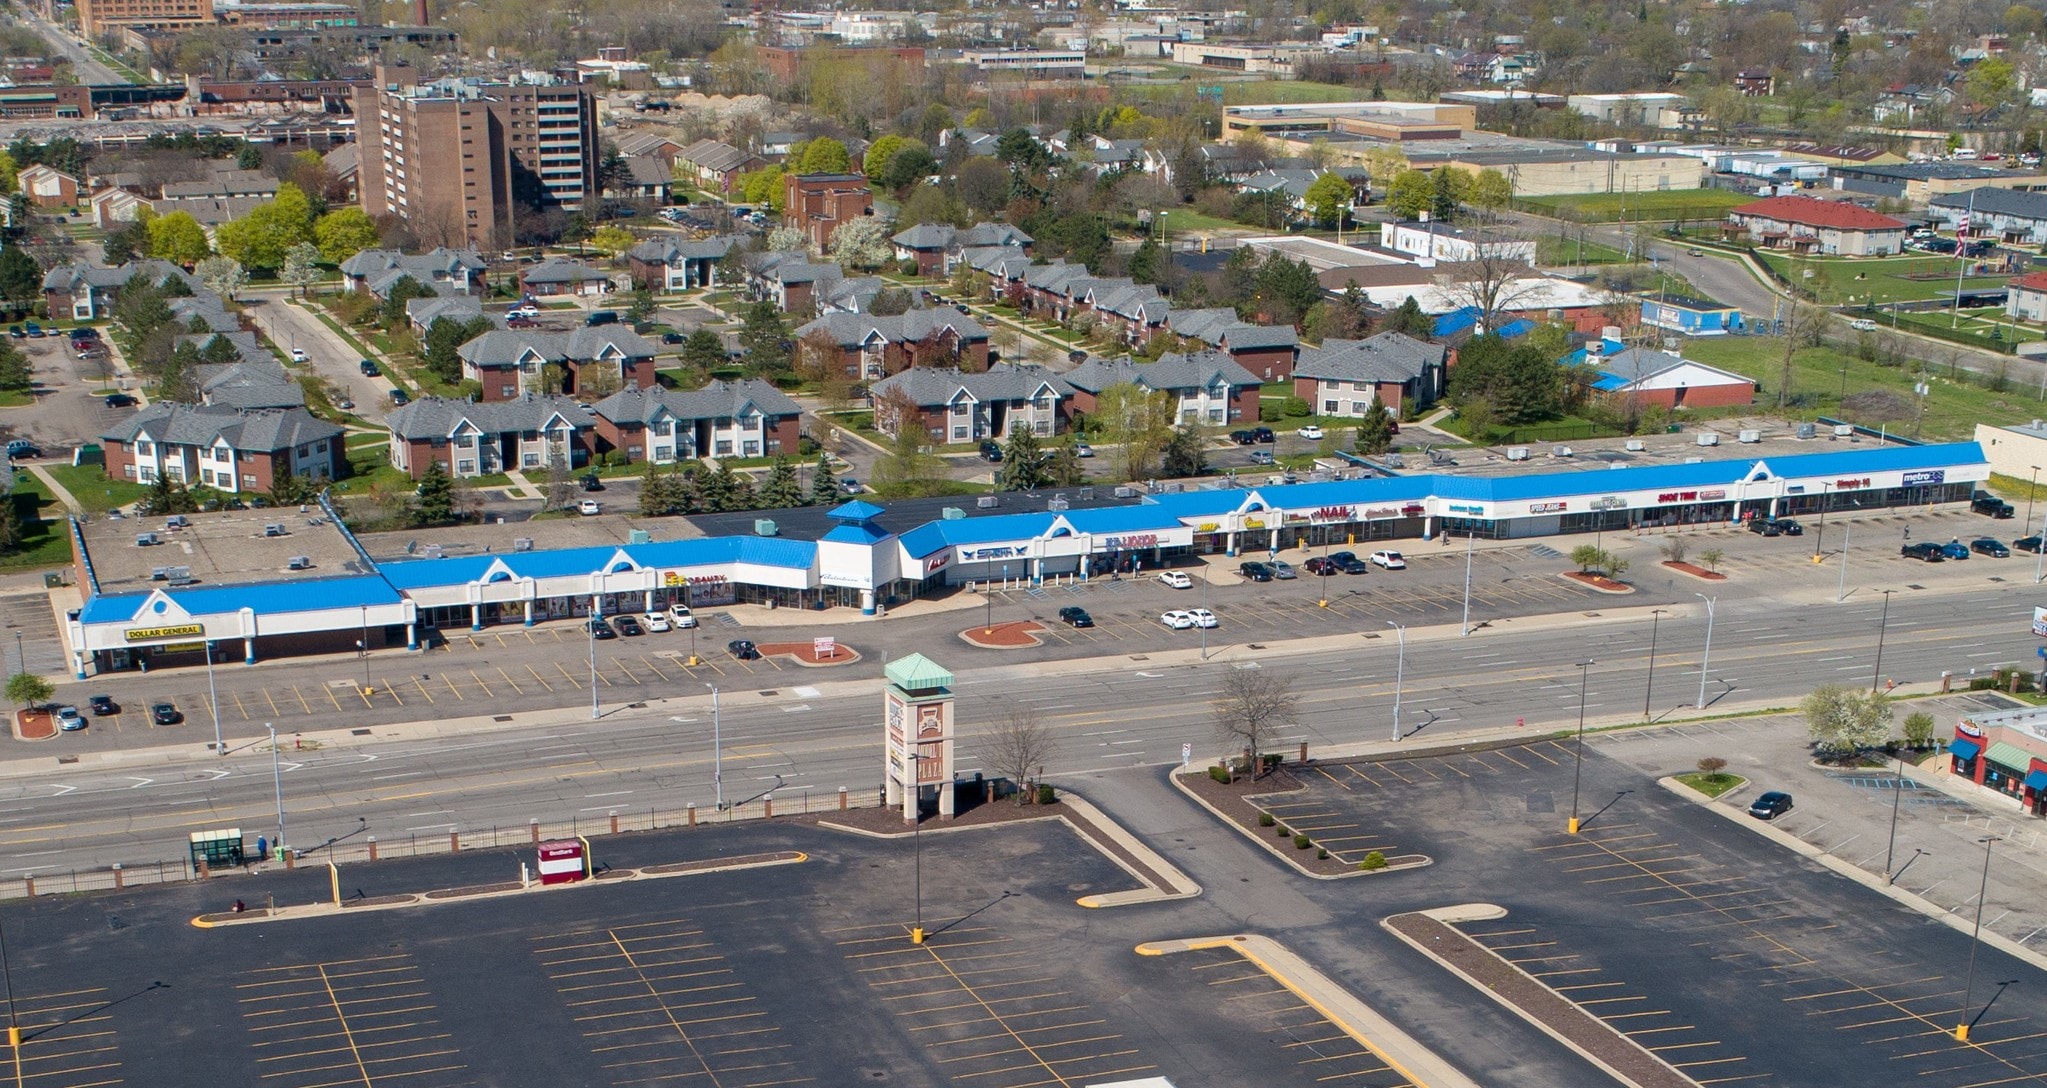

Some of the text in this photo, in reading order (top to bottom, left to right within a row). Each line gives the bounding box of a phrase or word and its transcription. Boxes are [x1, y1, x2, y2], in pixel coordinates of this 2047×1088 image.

[129, 626, 198, 638] DOLLAR GENERAL
[917, 761, 943, 779] PLAZA
